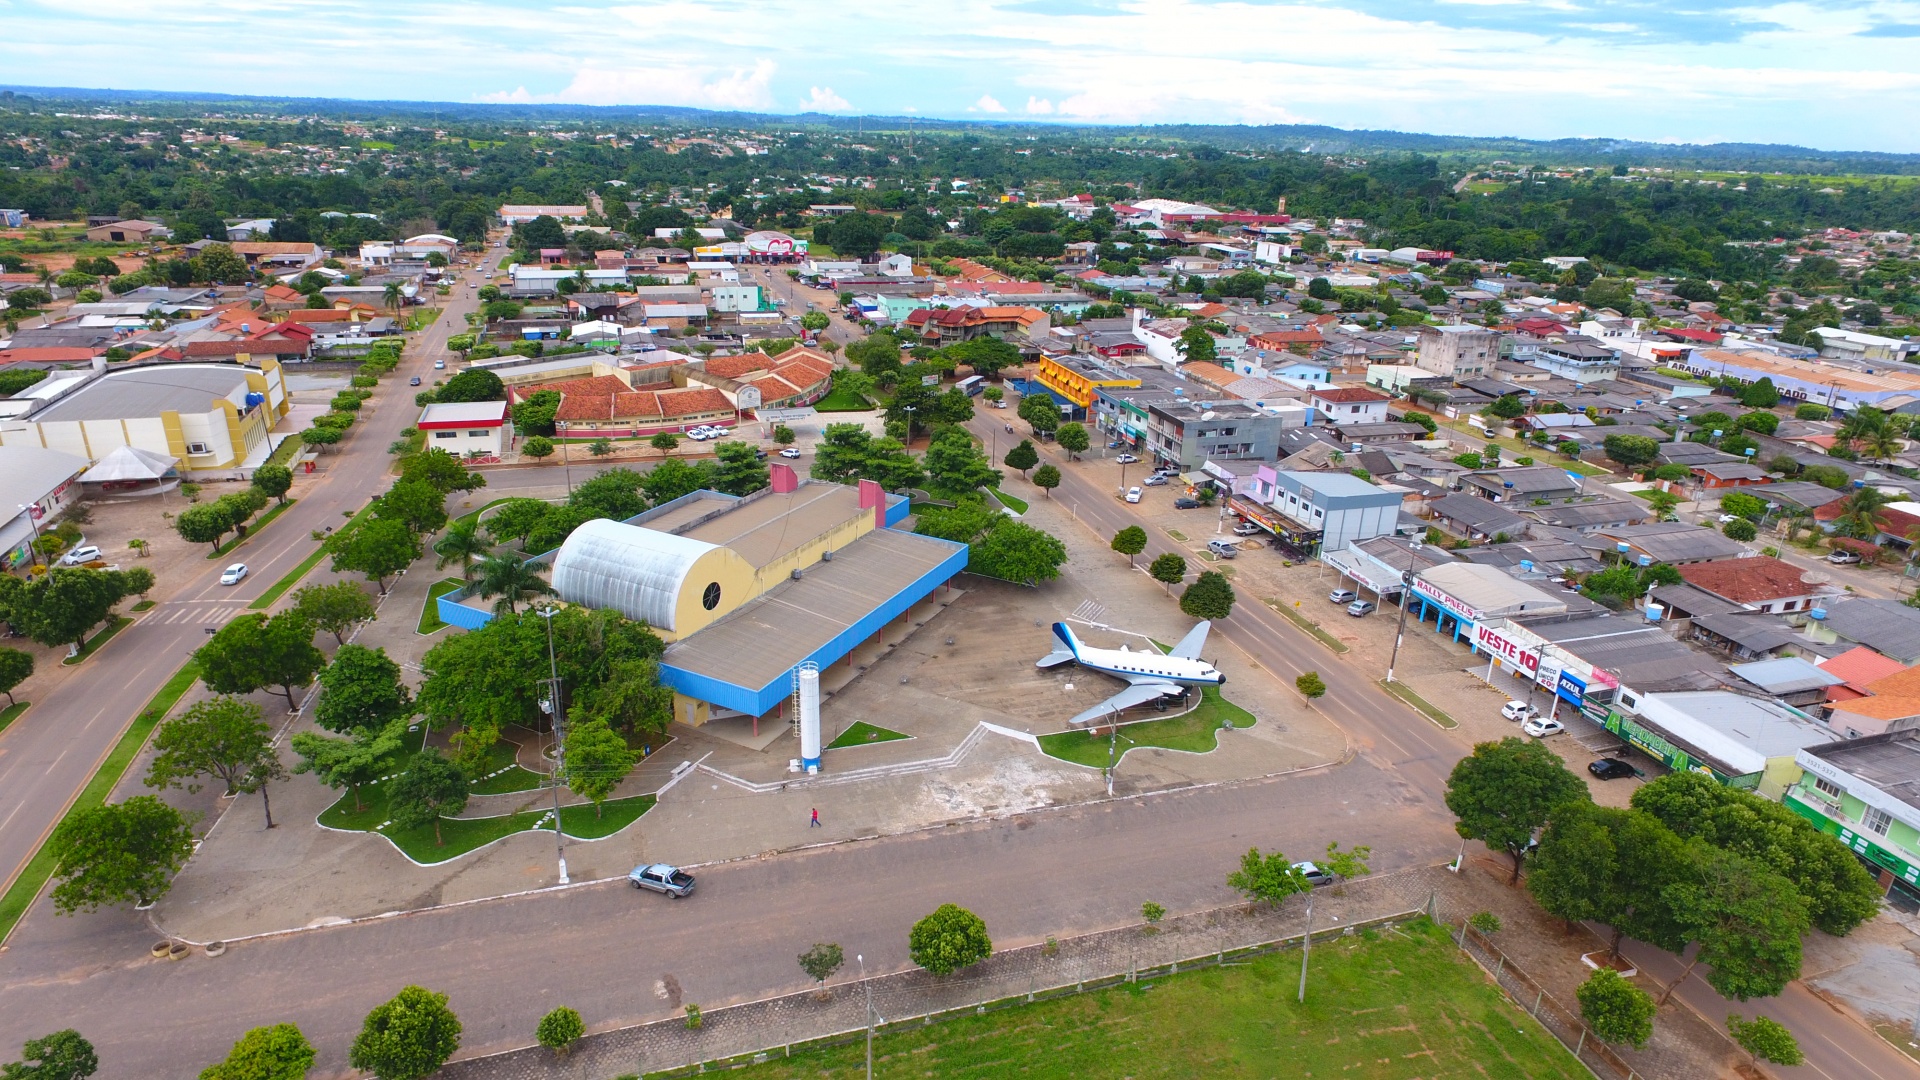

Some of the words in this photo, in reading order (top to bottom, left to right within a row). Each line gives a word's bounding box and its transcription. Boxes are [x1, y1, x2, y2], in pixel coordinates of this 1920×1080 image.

[1671, 362, 1711, 377] ARAUJO
[1417, 580, 1442, 598] RALLY
[1444, 595, 1473, 617] PNEUS
[1479, 626, 1517, 659] VESTE
[1519, 650, 1538, 672] 10
[1560, 678, 1581, 695] AZUL
[1605, 711, 1620, 735] A
[1621, 717, 1688, 771] VERDADEIRA
